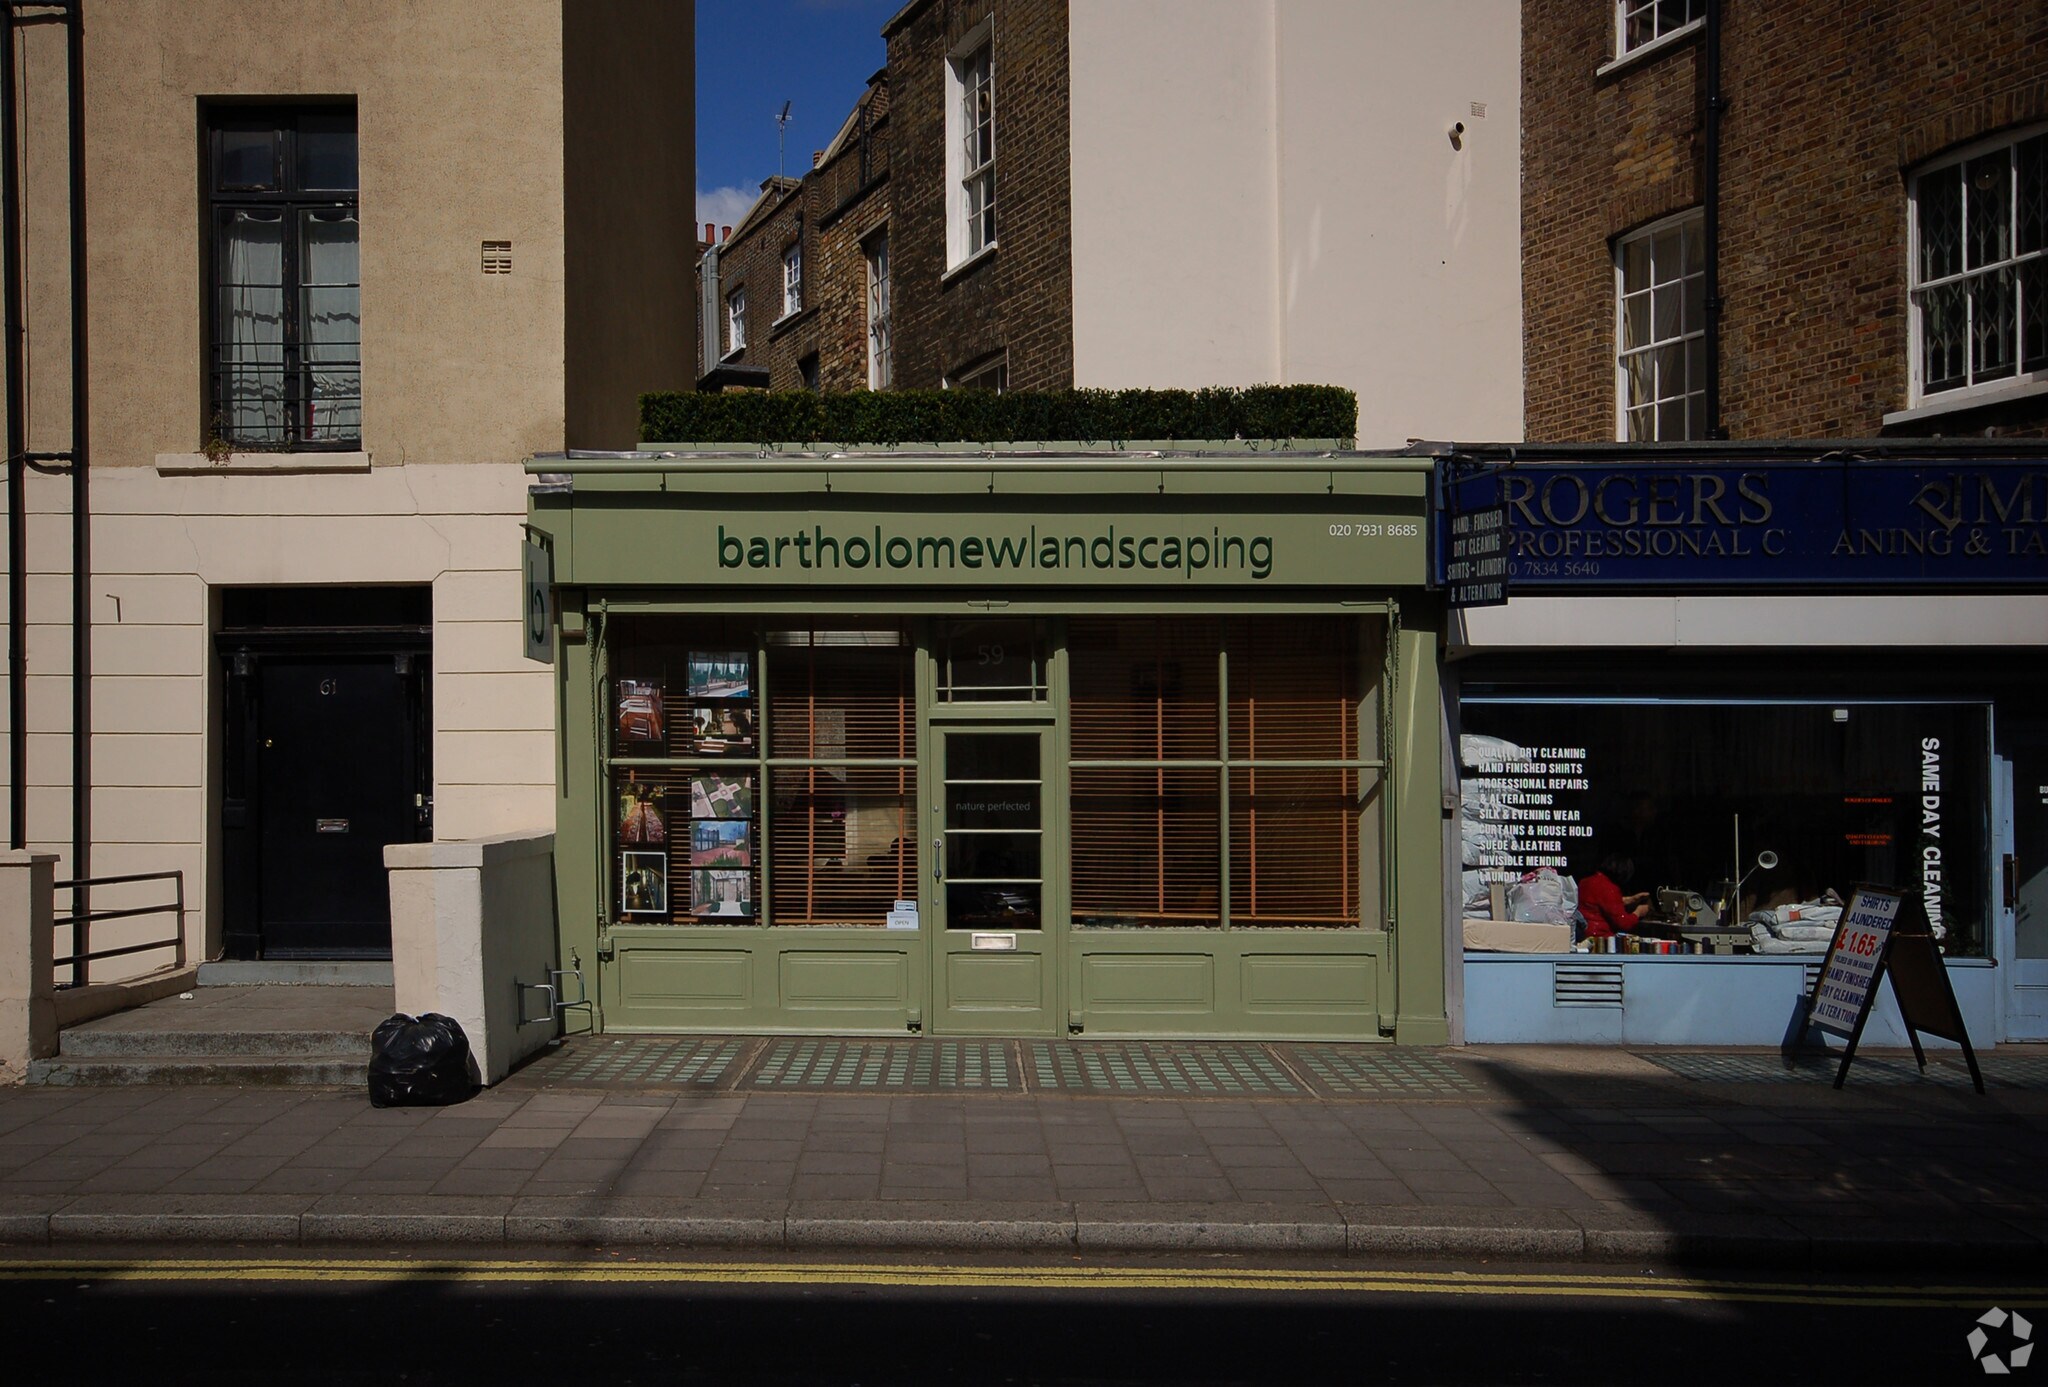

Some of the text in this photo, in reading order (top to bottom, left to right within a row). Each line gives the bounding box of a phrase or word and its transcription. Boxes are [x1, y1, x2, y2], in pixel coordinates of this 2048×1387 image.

[1500, 473, 1773, 527] ROGERS
[1328, 524, 1418, 536] 020 7931 8685
[1452, 509, 1503, 535] HAND FINISHED
[1453, 533, 1500, 558] DRY CLEANING
[1964, 527, 1993, 557] &
[717, 525, 1274, 579] bartholomewlandscaping
[1524, 561, 1559, 576] 7834
[1564, 561, 1600, 576] 5640
[1460, 582, 1502, 602] ALTERATIONS
[978, 644, 1005, 666] 59
[320, 678, 337, 696] 61
[1520, 747, 1538, 759] DRY
[1540, 748, 1586, 759] CLEANING
[1478, 763, 1583, 774] HAND FINISHED SHIRTS
[1921, 737, 1940, 792] SAME
[1478, 778, 1589, 790] PROFESSIONAL REPAIRS
[955, 800, 1031, 813] nature perfected
[1479, 794, 1553, 805] & ALTERATIONS
[1479, 809, 1580, 821] SILK & EVENING WEAR
[1922, 796, 1941, 838] DAY
[1479, 825, 1593, 837] CURTAINS & HOUSE HOLD
[1479, 840, 1561, 852] SUEDE & LEATHER
[1479, 856, 1567, 867] INVISIBLE MENDING
[1479, 872, 1522, 882] LAUNDRY
[1861, 895, 1891, 912] SHIRTS
[1827, 966, 1872, 989] HAND FINISHED
